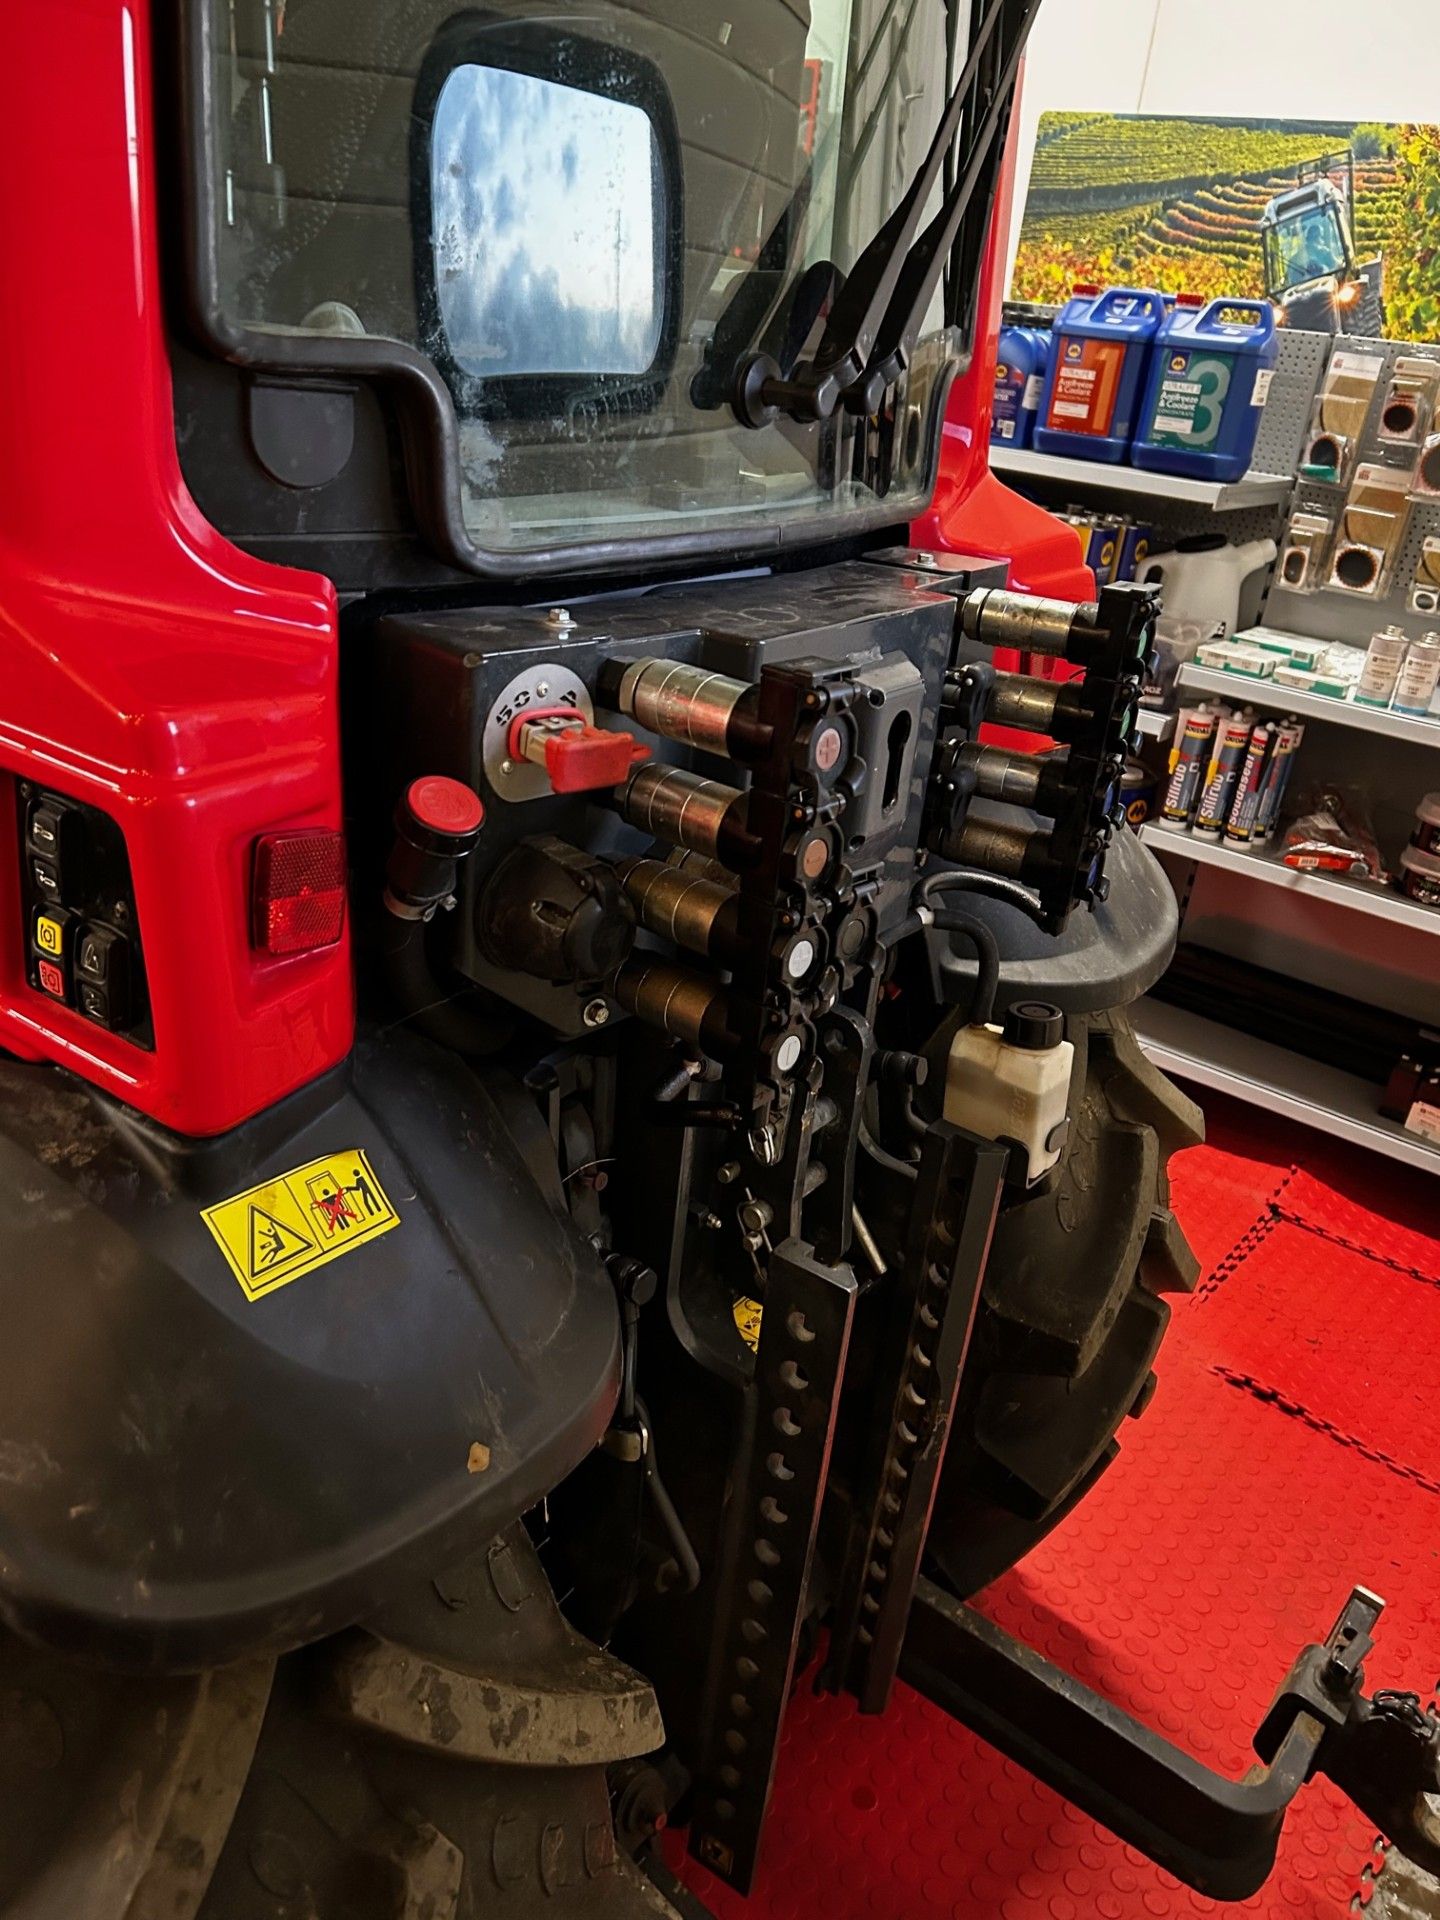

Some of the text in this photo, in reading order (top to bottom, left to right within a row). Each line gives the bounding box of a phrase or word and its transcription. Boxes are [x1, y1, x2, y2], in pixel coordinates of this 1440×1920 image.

[1092, 347, 1120, 430] 1
[1160, 391, 1199, 404] Antifreeze
[1166, 400, 1196, 411] Coolant
[1176, 360, 1231, 445] 3
[495, 690, 531, 727] 50
[1200, 773, 1224, 818] Silirub
